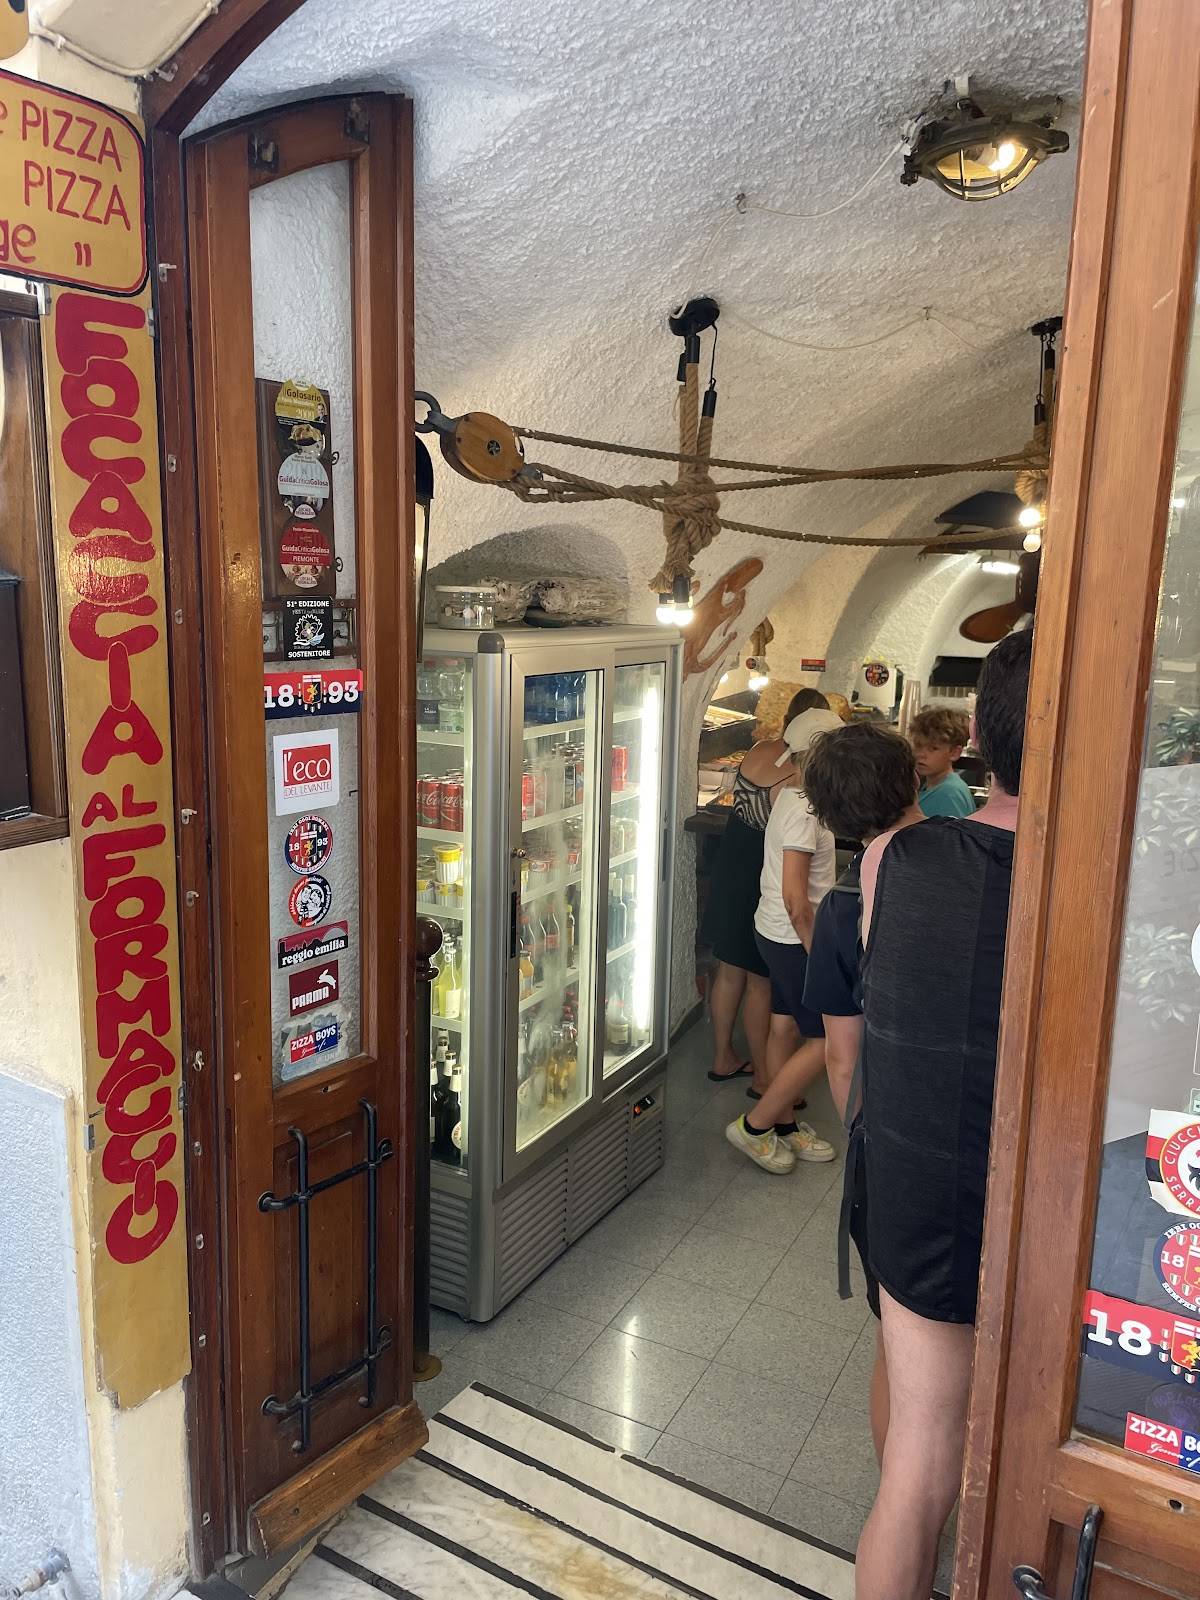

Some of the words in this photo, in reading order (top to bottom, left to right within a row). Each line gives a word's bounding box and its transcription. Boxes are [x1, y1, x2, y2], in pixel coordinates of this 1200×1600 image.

[22, 100, 122, 172] PIZZA
[24, 160, 131, 231] PIZZA
[55, 292, 163, 775] FOCACCIA
[288, 650, 331, 658] SOSTENITORE
[264, 684, 294, 708] 18
[328, 681, 359, 703] 93
[283, 751, 331, 782] l'eco
[285, 787, 298, 797] DEL
[300, 781, 332, 794] LEVANTE
[81, 784, 157, 828] AL
[288, 842, 300, 852] 18
[317, 837, 329, 846] 93
[282, 949, 313, 967] reggio
[314, 938, 345, 956] emilia
[291, 986, 330, 1010] PARMA
[291, 1034, 314, 1051] ZIZZA
[315, 1024, 336, 1042] BOYS
[1163, 1224, 1187, 1239] IERI
[1160, 1250, 1184, 1268] 18
[1087, 1308, 1152, 1357] 18
[1129, 1415, 1179, 1448] ZIZZA
